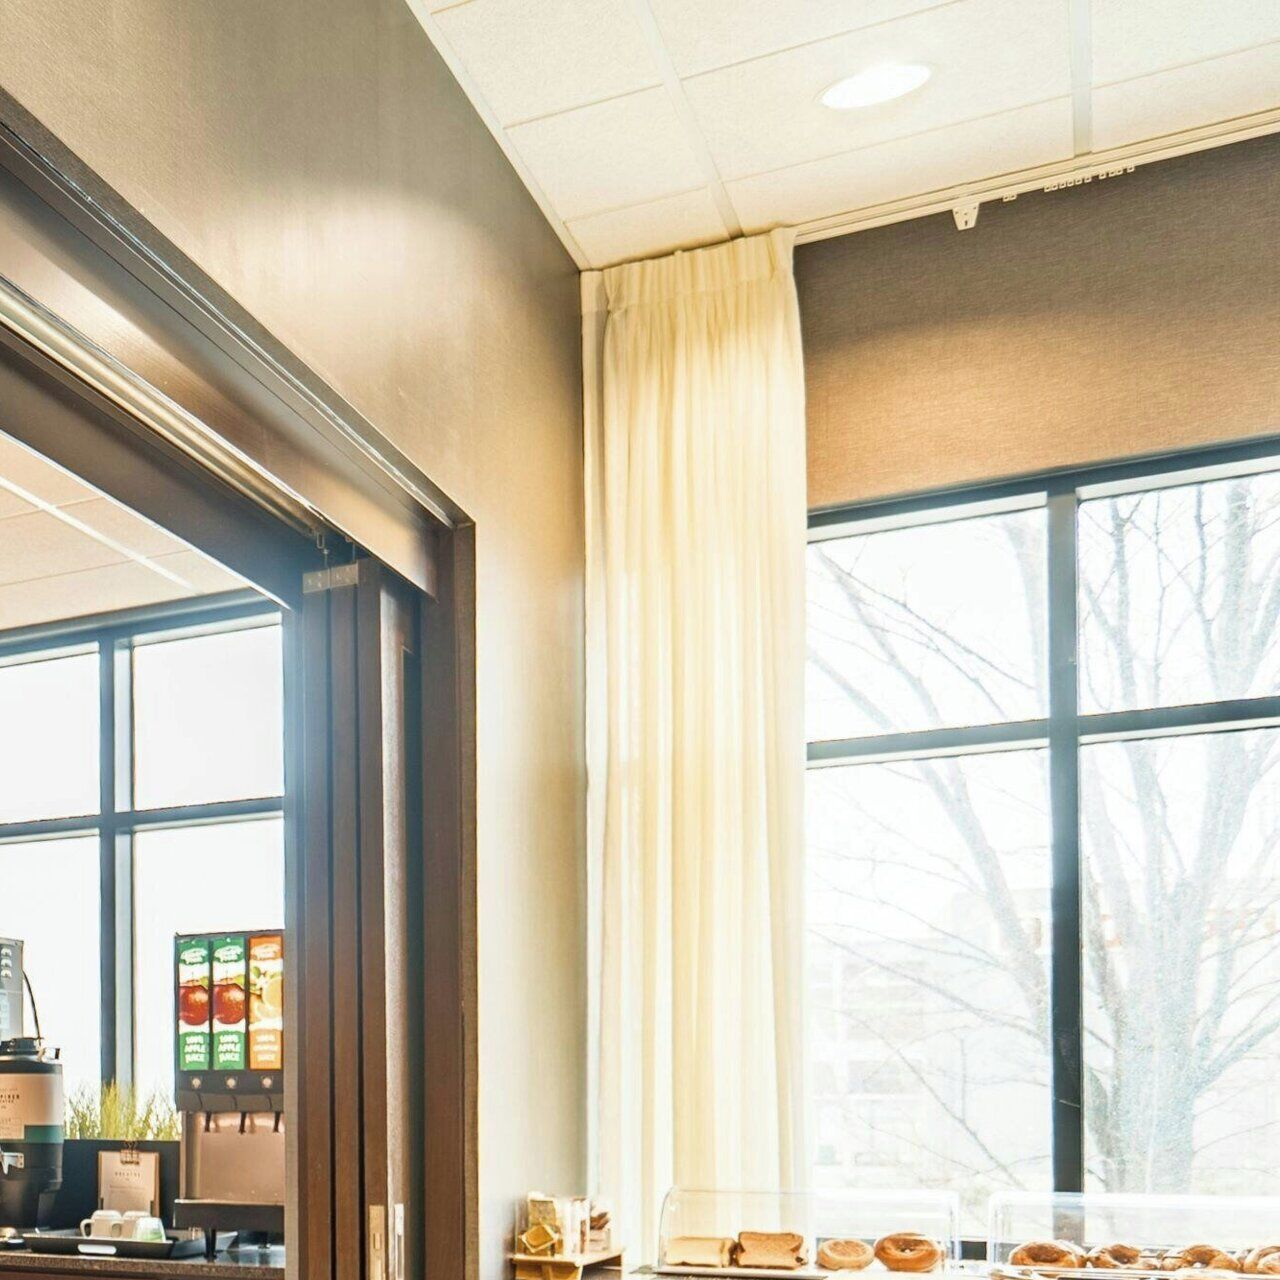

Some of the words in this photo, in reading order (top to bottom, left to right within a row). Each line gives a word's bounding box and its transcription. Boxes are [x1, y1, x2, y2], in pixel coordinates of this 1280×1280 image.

[184, 1044, 206, 1053] APPLE
[218, 1043, 241, 1052] APPLE
[185, 1053, 205, 1063] JUICE
[219, 1053, 240, 1063] JUICE
